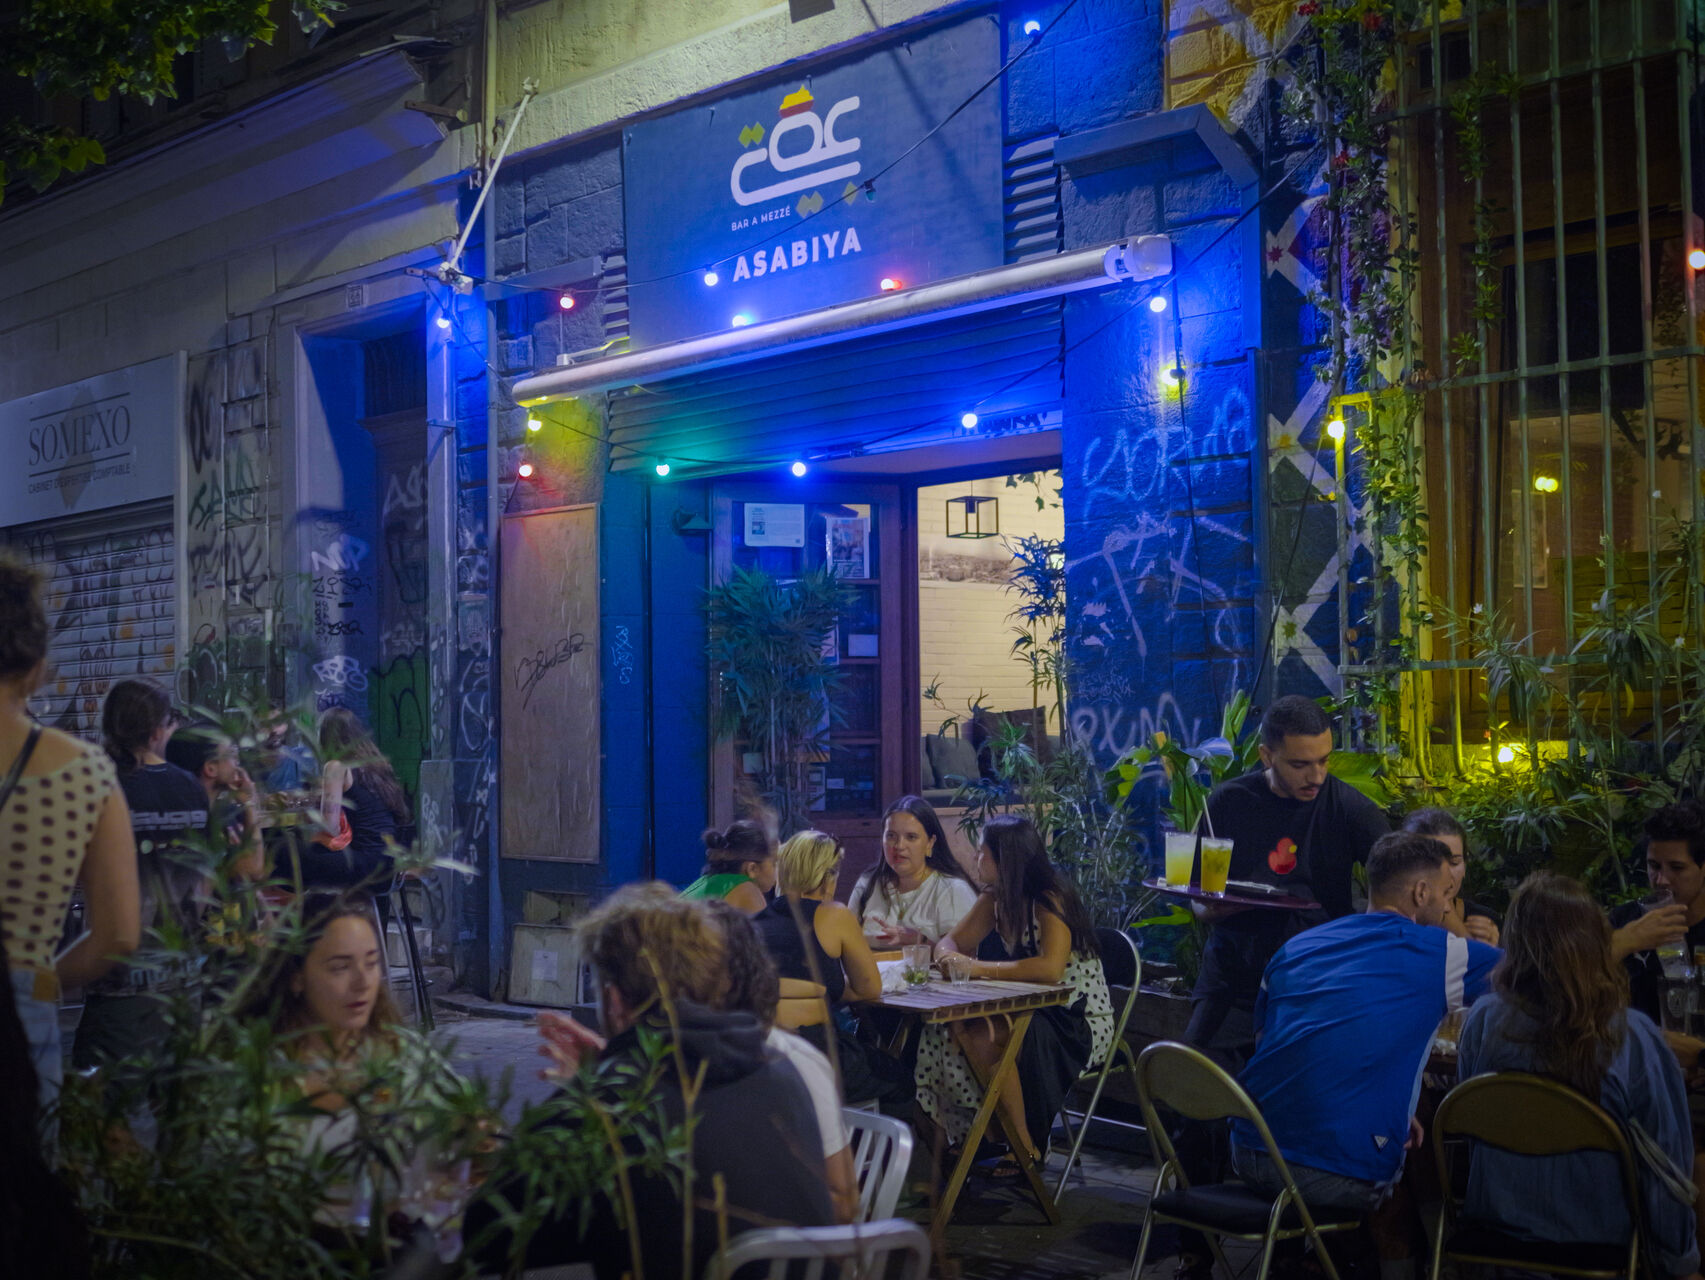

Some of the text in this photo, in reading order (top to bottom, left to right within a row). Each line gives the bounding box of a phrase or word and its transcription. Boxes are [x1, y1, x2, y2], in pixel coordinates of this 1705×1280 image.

[731, 205, 791, 231] BAR A MEZZÉ
[733, 226, 862, 283] ASABIYA
[28, 405, 131, 466] SOMEXO
[28, 480, 53, 495] CABINET
[92, 462, 131, 481] COMPTABLE
